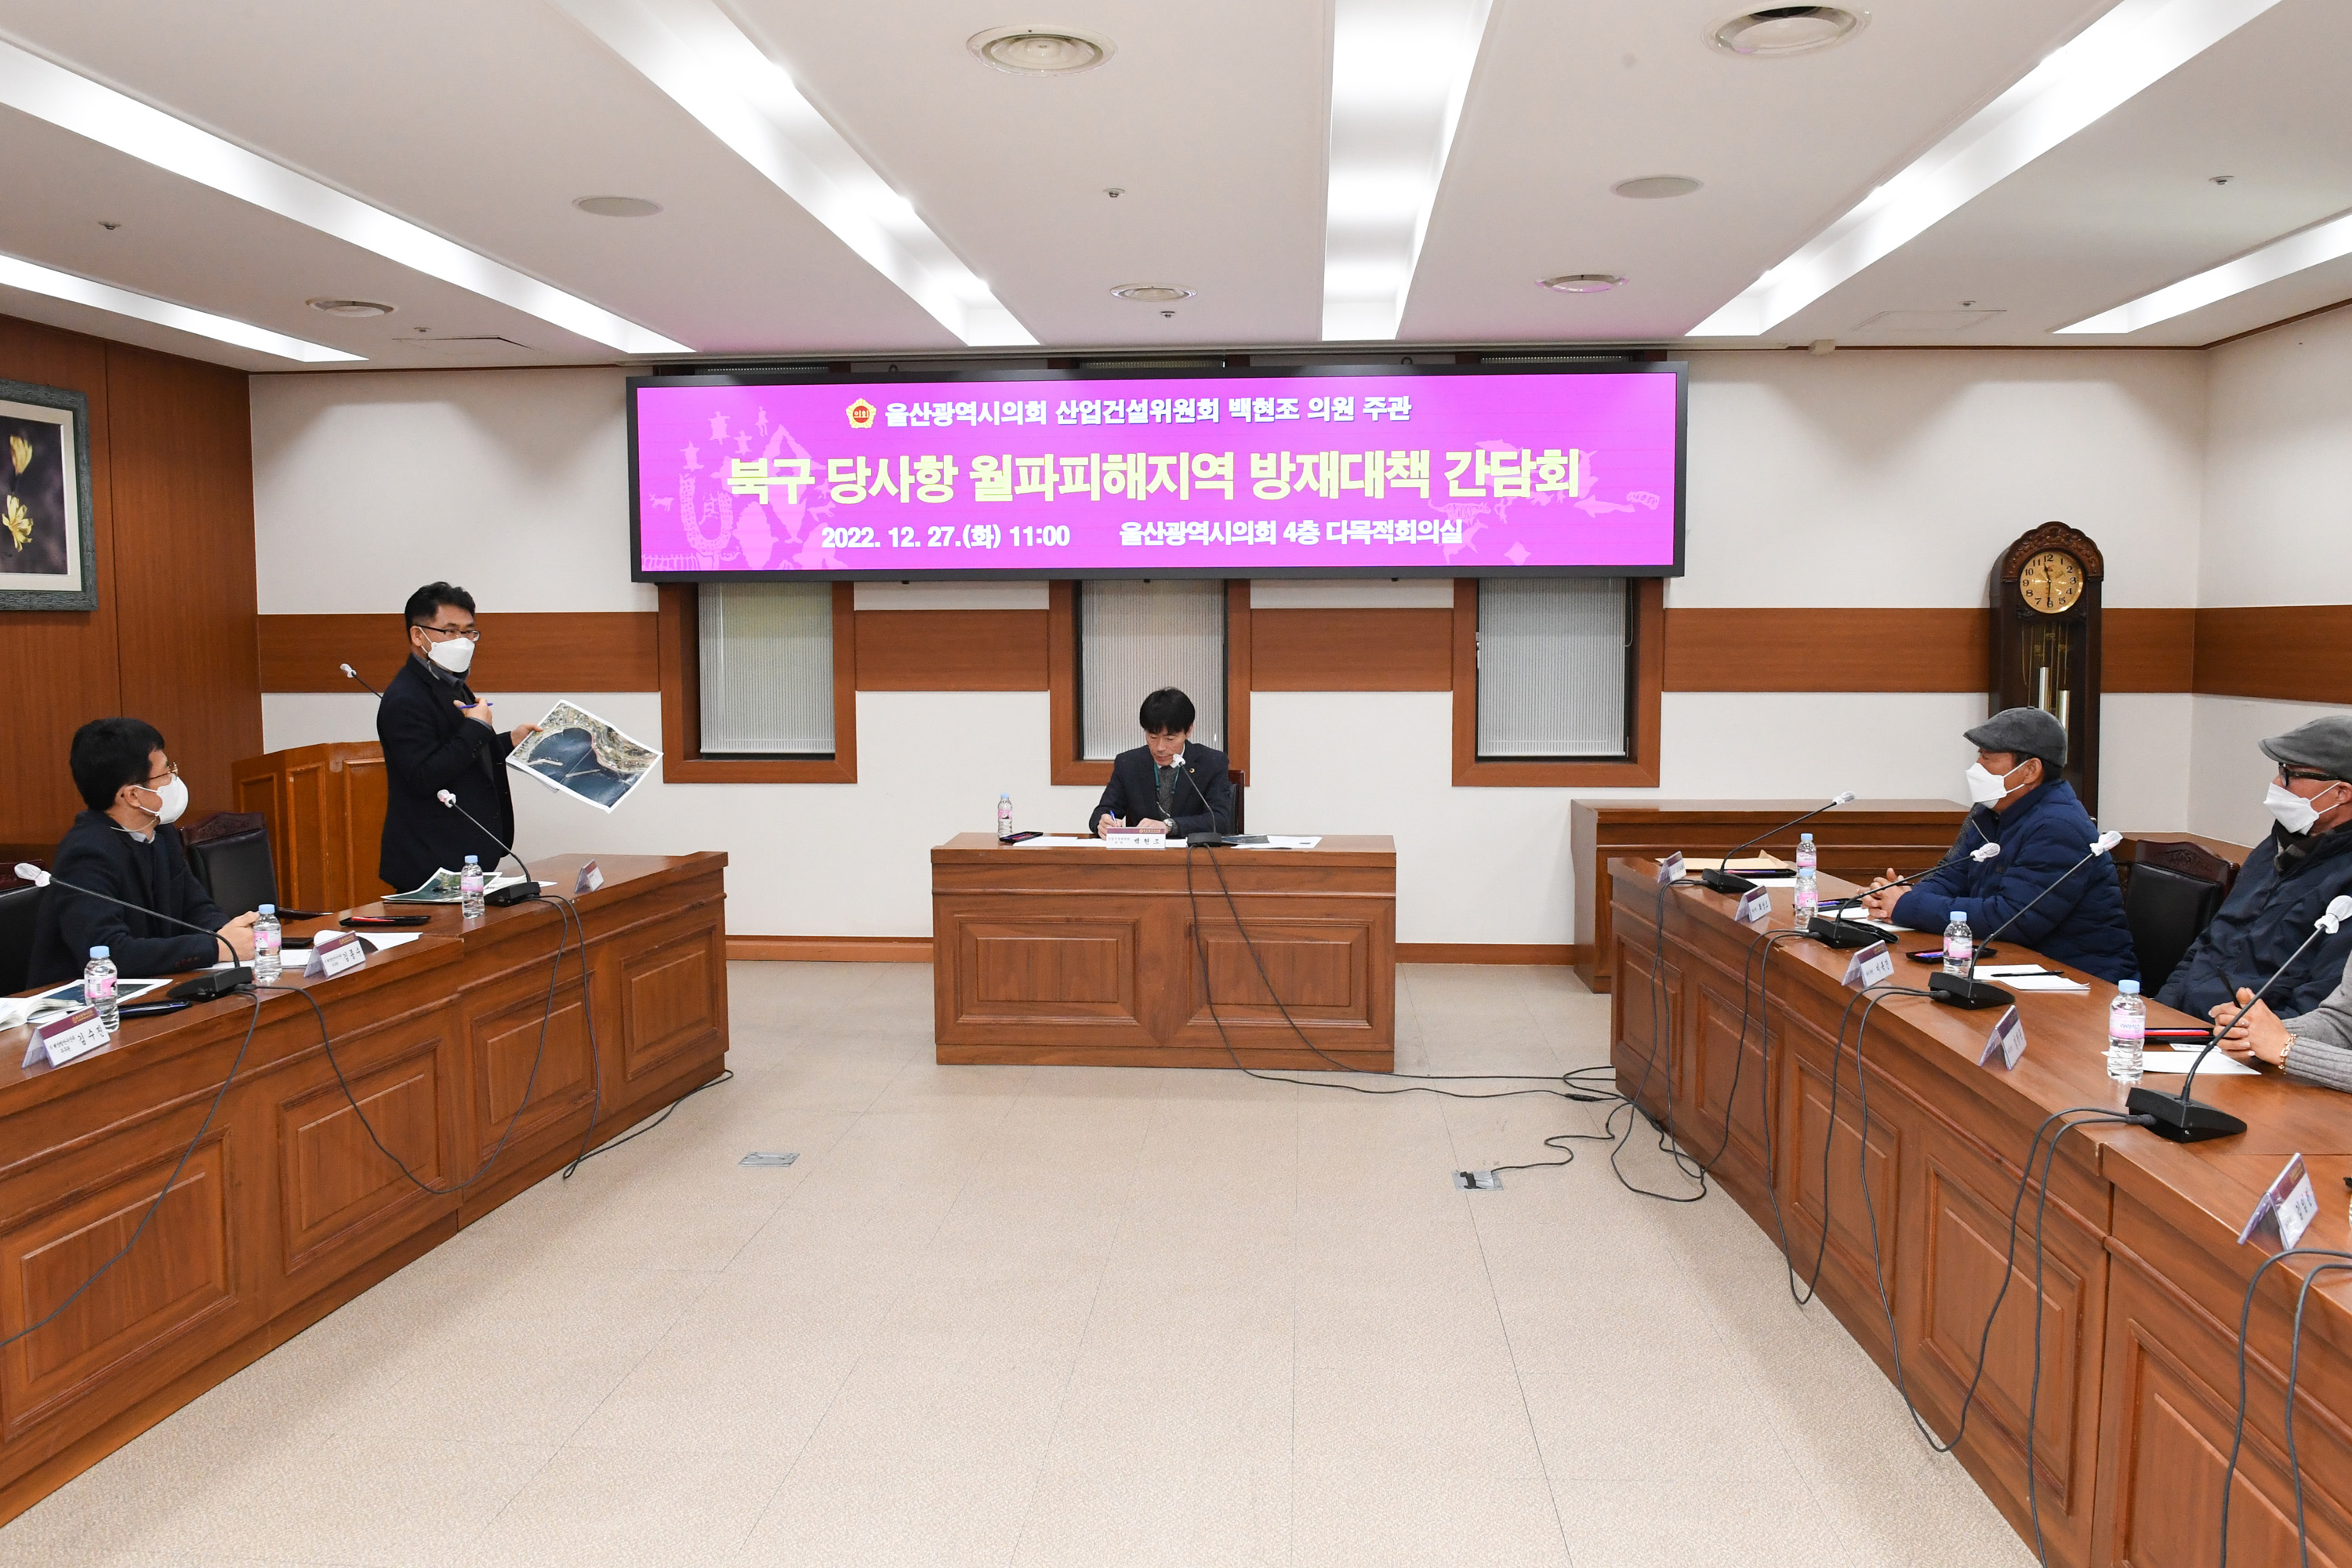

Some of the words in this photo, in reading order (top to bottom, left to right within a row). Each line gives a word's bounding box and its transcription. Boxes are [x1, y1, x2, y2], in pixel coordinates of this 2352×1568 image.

[854, 409, 869, 418] 의회
[884, 401, 1047, 428] 울산광역시의회
[1055, 397, 1220, 426] 산업건설위원회
[1229, 397, 1300, 424] 백현조
[1307, 396, 1355, 423] 의원
[1363, 395, 1412, 423] 주관
[727, 457, 815, 505] 북구
[827, 454, 959, 505] 당사항
[969, 451, 1236, 503] 월파피해지역
[1250, 449, 1432, 501] 방재대책
[1443, 448, 1581, 499] 간담회
[821, 526, 880, 548] 2022.
[887, 526, 921, 548] 12.
[927, 524, 1002, 550] 27.(화)
[1009, 524, 1071, 547] 11:00
[1119, 520, 1277, 547] 울산광역시의회
[1283, 519, 1321, 546] 4층
[1326, 518, 1464, 546] 다목적회의실
[77, 1025, 104, 1046] 김수진
